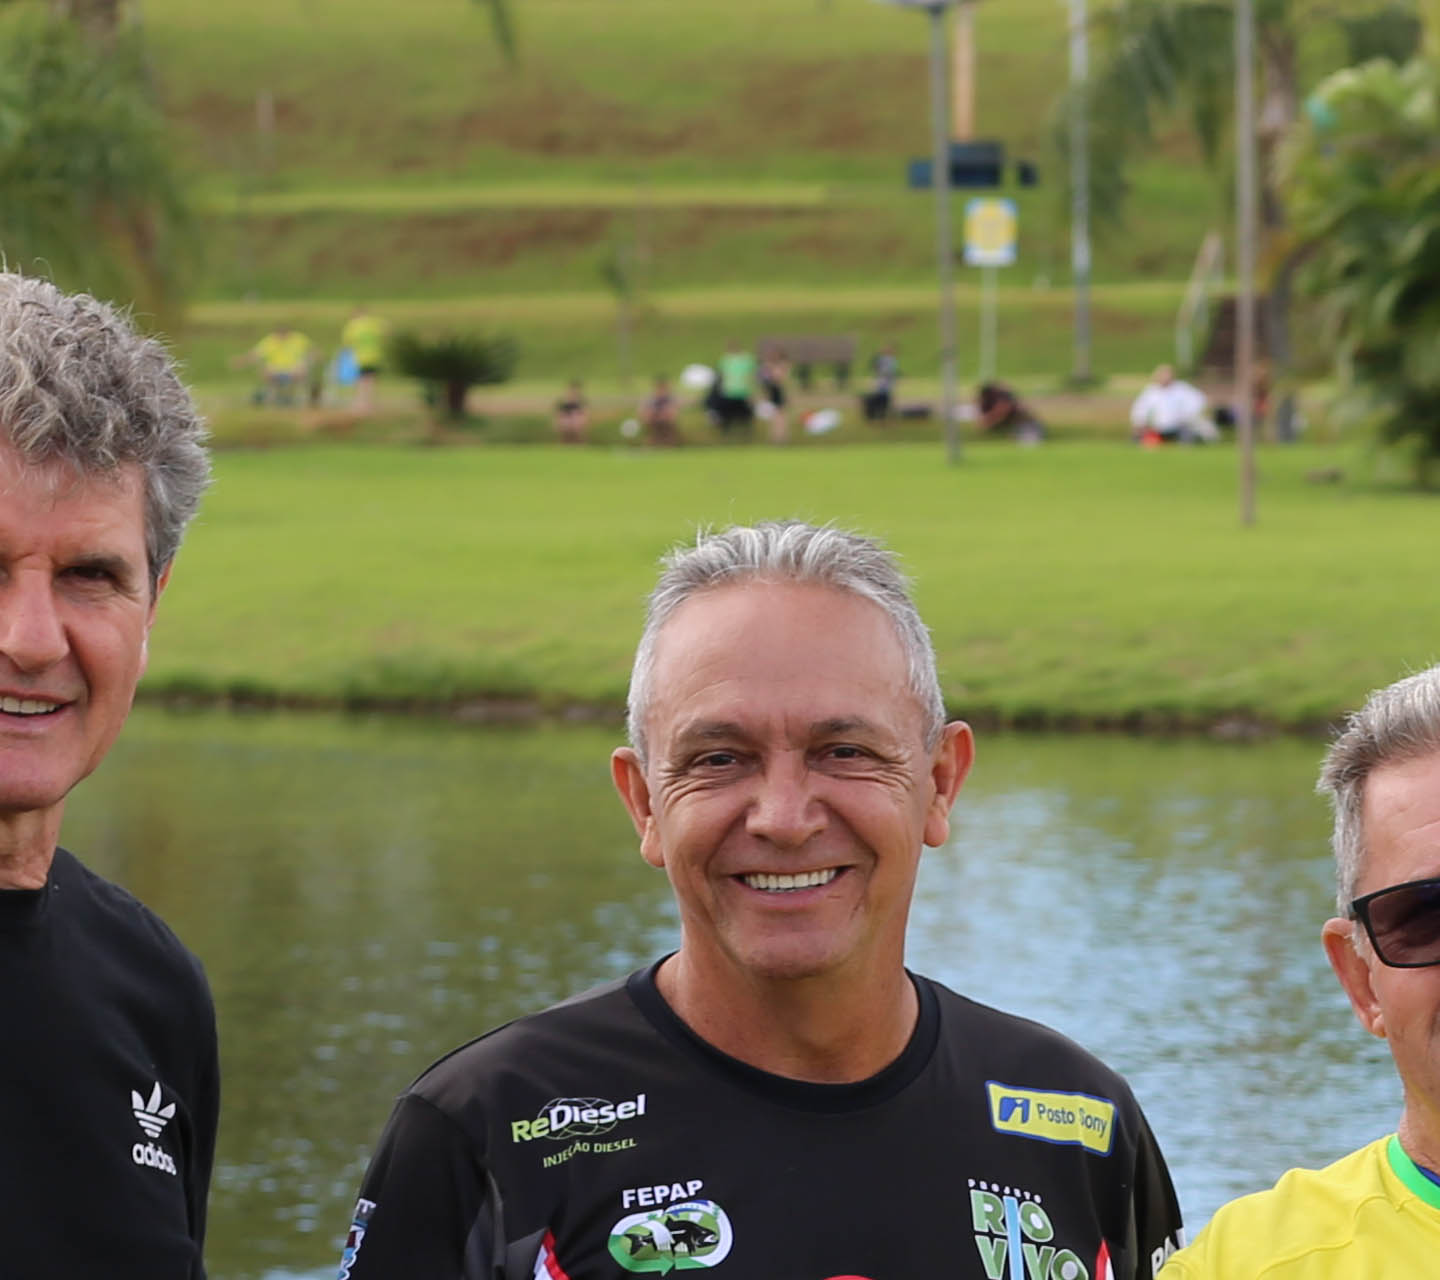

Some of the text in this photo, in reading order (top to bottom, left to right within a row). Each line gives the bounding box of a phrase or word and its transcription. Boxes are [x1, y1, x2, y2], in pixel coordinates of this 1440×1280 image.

[511, 1094, 646, 1143] ReDiesel
[1037, 1103, 1075, 1124] Posto
[543, 1138, 637, 1168] INJEÇÃO DIESEL
[622, 1180, 704, 1210] FEPAP
[970, 1190, 1054, 1243] RIO
